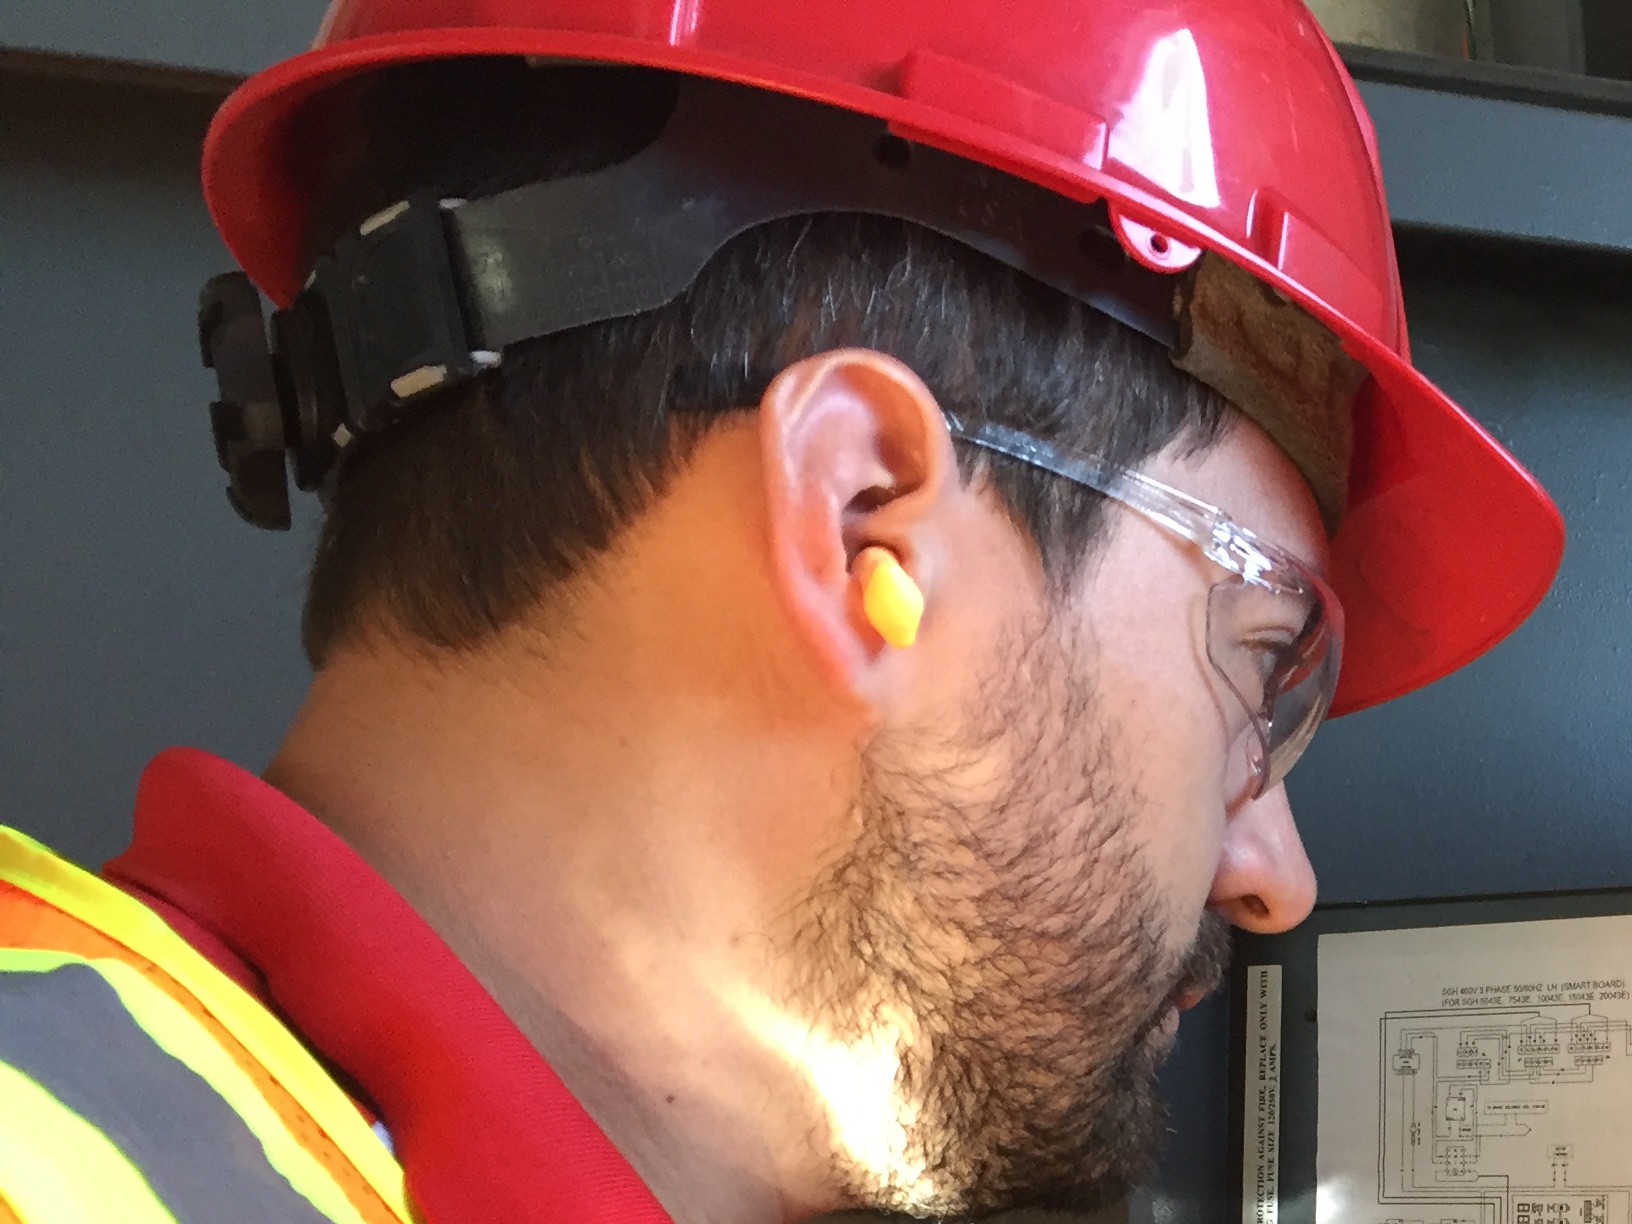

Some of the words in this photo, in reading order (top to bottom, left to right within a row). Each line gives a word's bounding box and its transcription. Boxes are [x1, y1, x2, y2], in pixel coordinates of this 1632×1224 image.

[1441, 987, 1458, 996] SGH
[1486, 984, 1511, 994] PHASE
[1561, 981, 1591, 992] (SMART
[1592, 979, 1625, 990] BOARD)
[1441, 998, 1460, 1007] (FOR
[1461, 998, 1479, 1006] SGH
[1258, 1117, 1266, 1161] AGAINST
